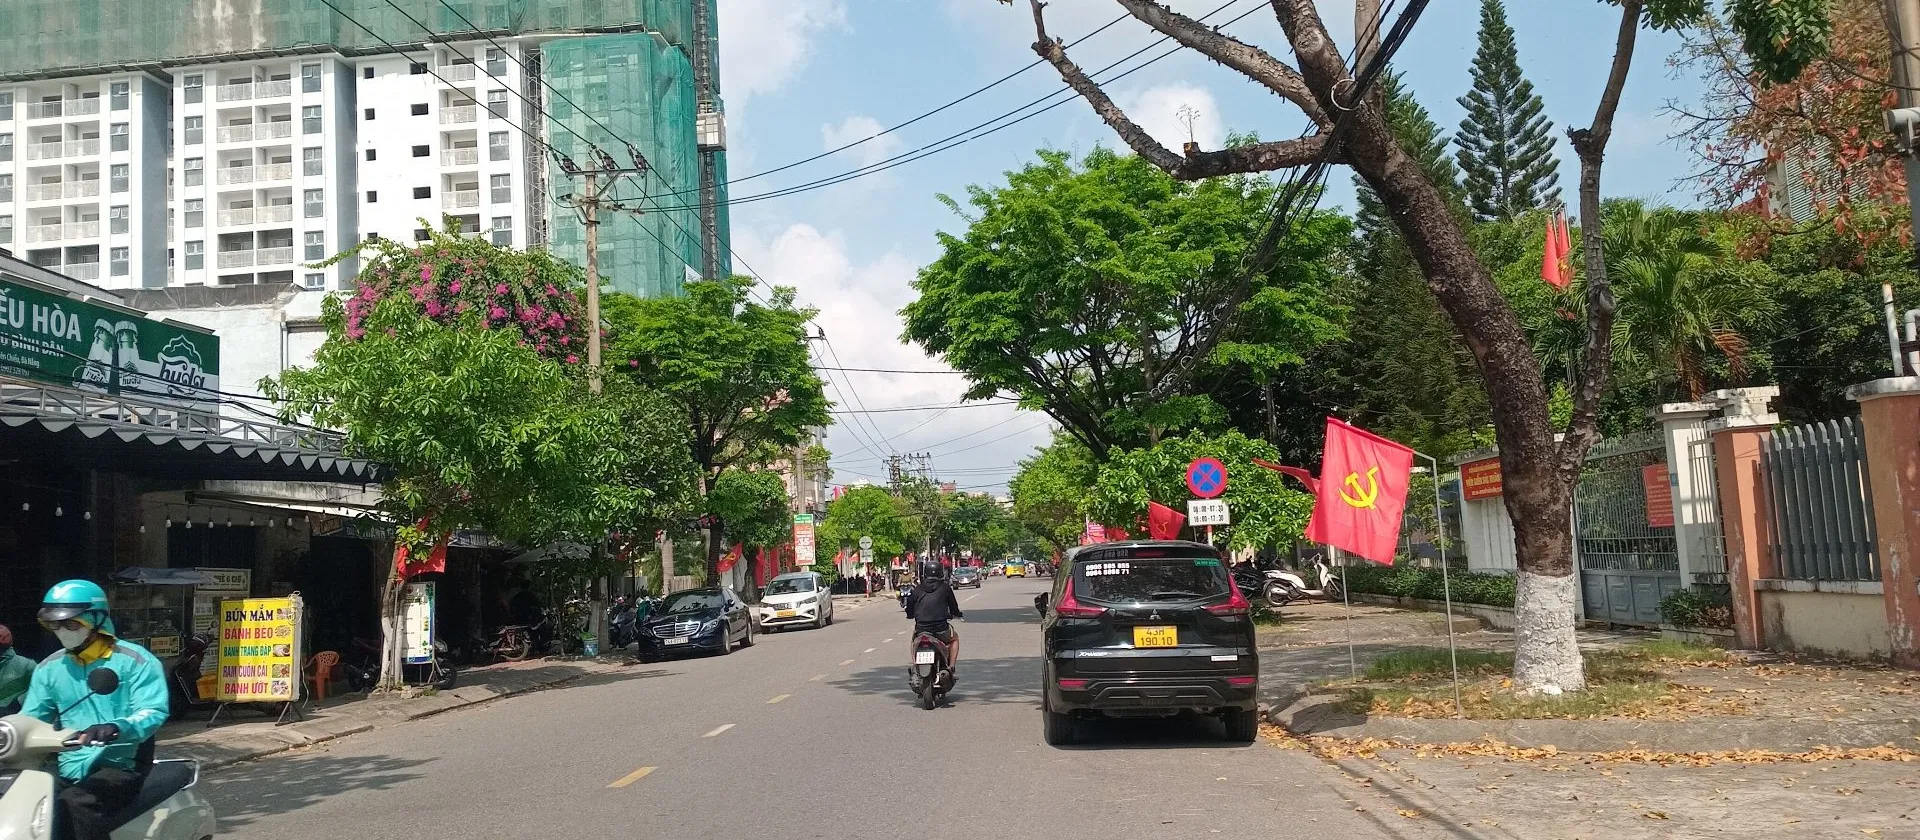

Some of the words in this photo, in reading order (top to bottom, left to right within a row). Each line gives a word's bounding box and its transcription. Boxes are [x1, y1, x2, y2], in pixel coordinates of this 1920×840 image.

[32, 303, 81, 342] HÒA
[225, 608, 247, 622] BÚN
[250, 604, 274, 622] MẮM
[1140, 636, 1173, 646] 190.10
[239, 661, 255, 678] CUỐN
[251, 680, 269, 694] ƯỚT
